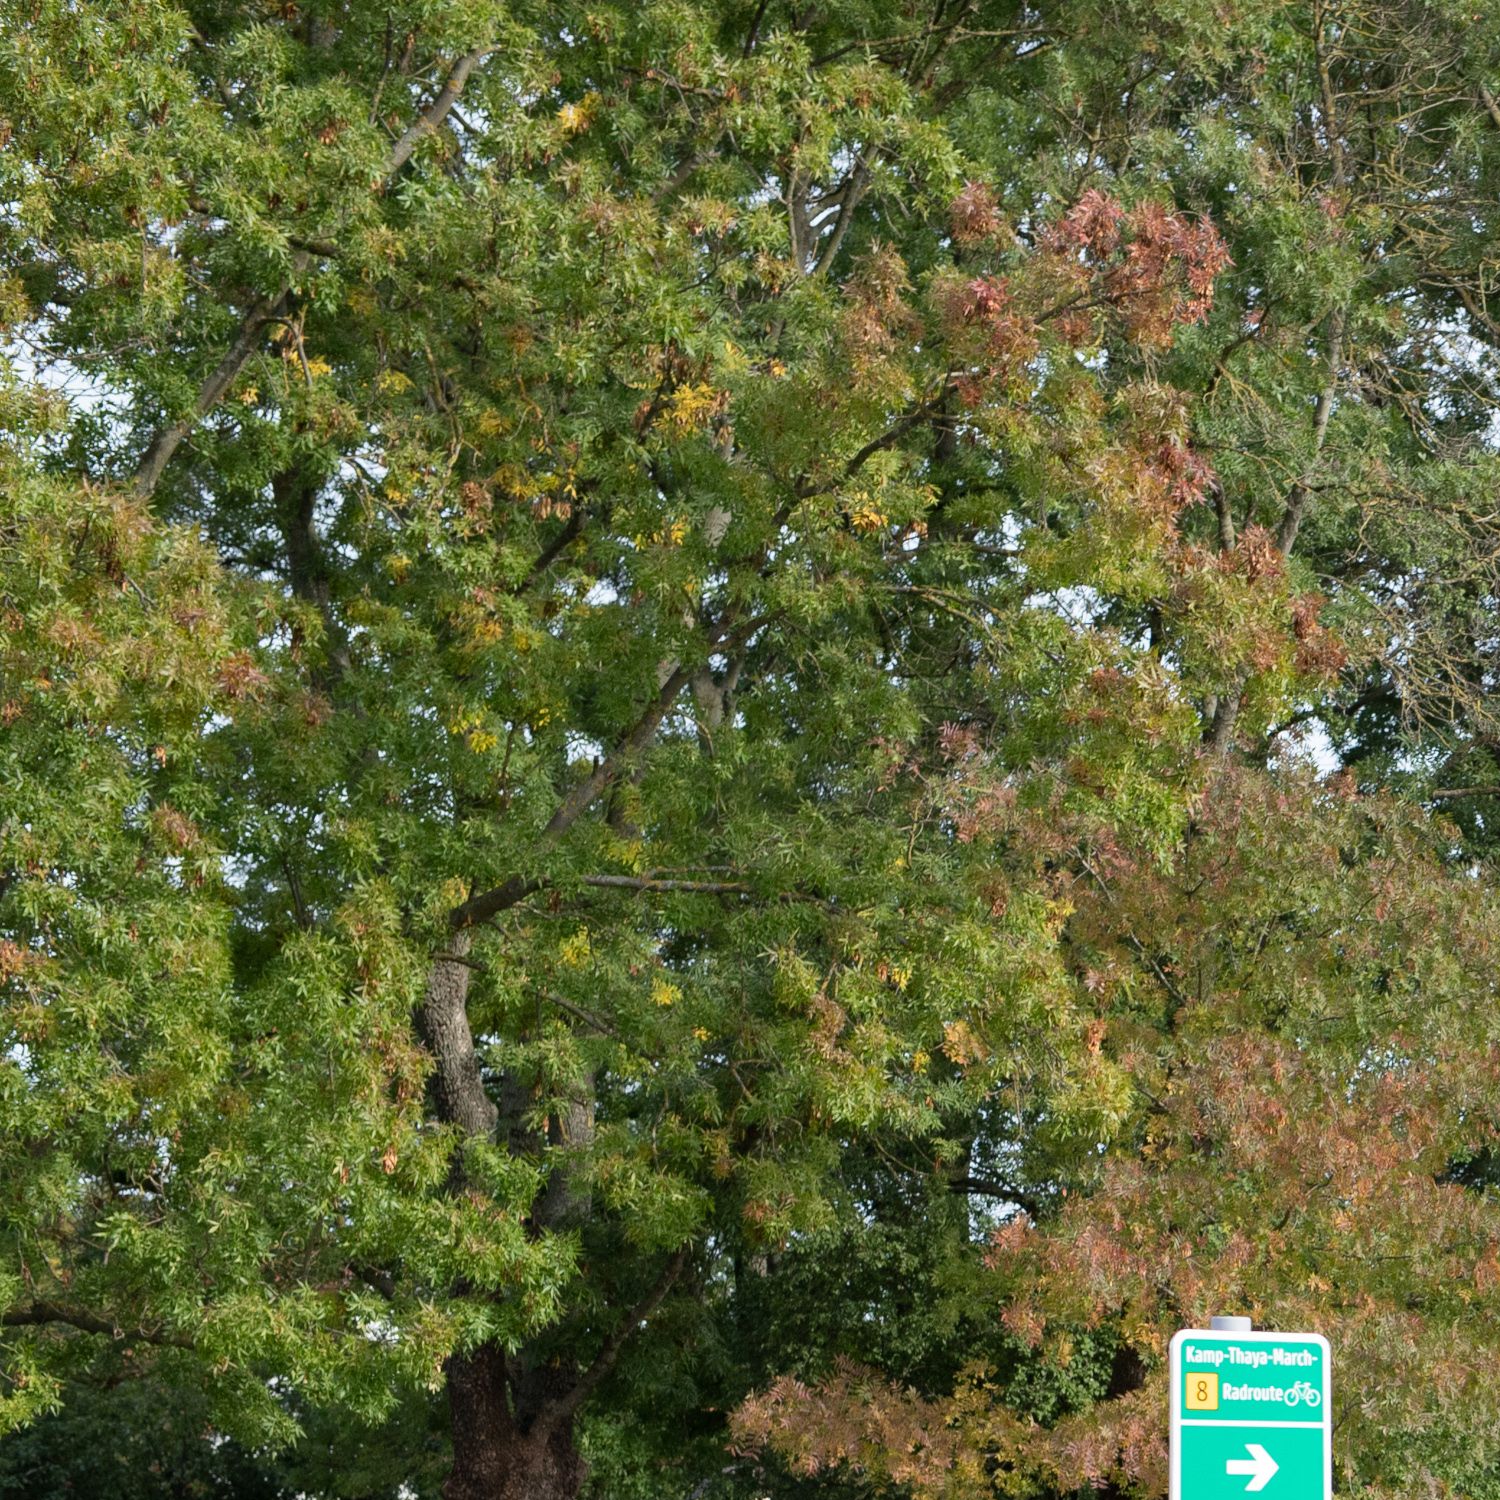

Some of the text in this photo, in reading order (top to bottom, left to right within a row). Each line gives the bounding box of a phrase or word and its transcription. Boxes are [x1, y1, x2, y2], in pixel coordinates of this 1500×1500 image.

[1186, 1346, 1318, 1368] Kamp-Thaya-March-
[1197, 1381, 1284, 1402] 8 Radroute
